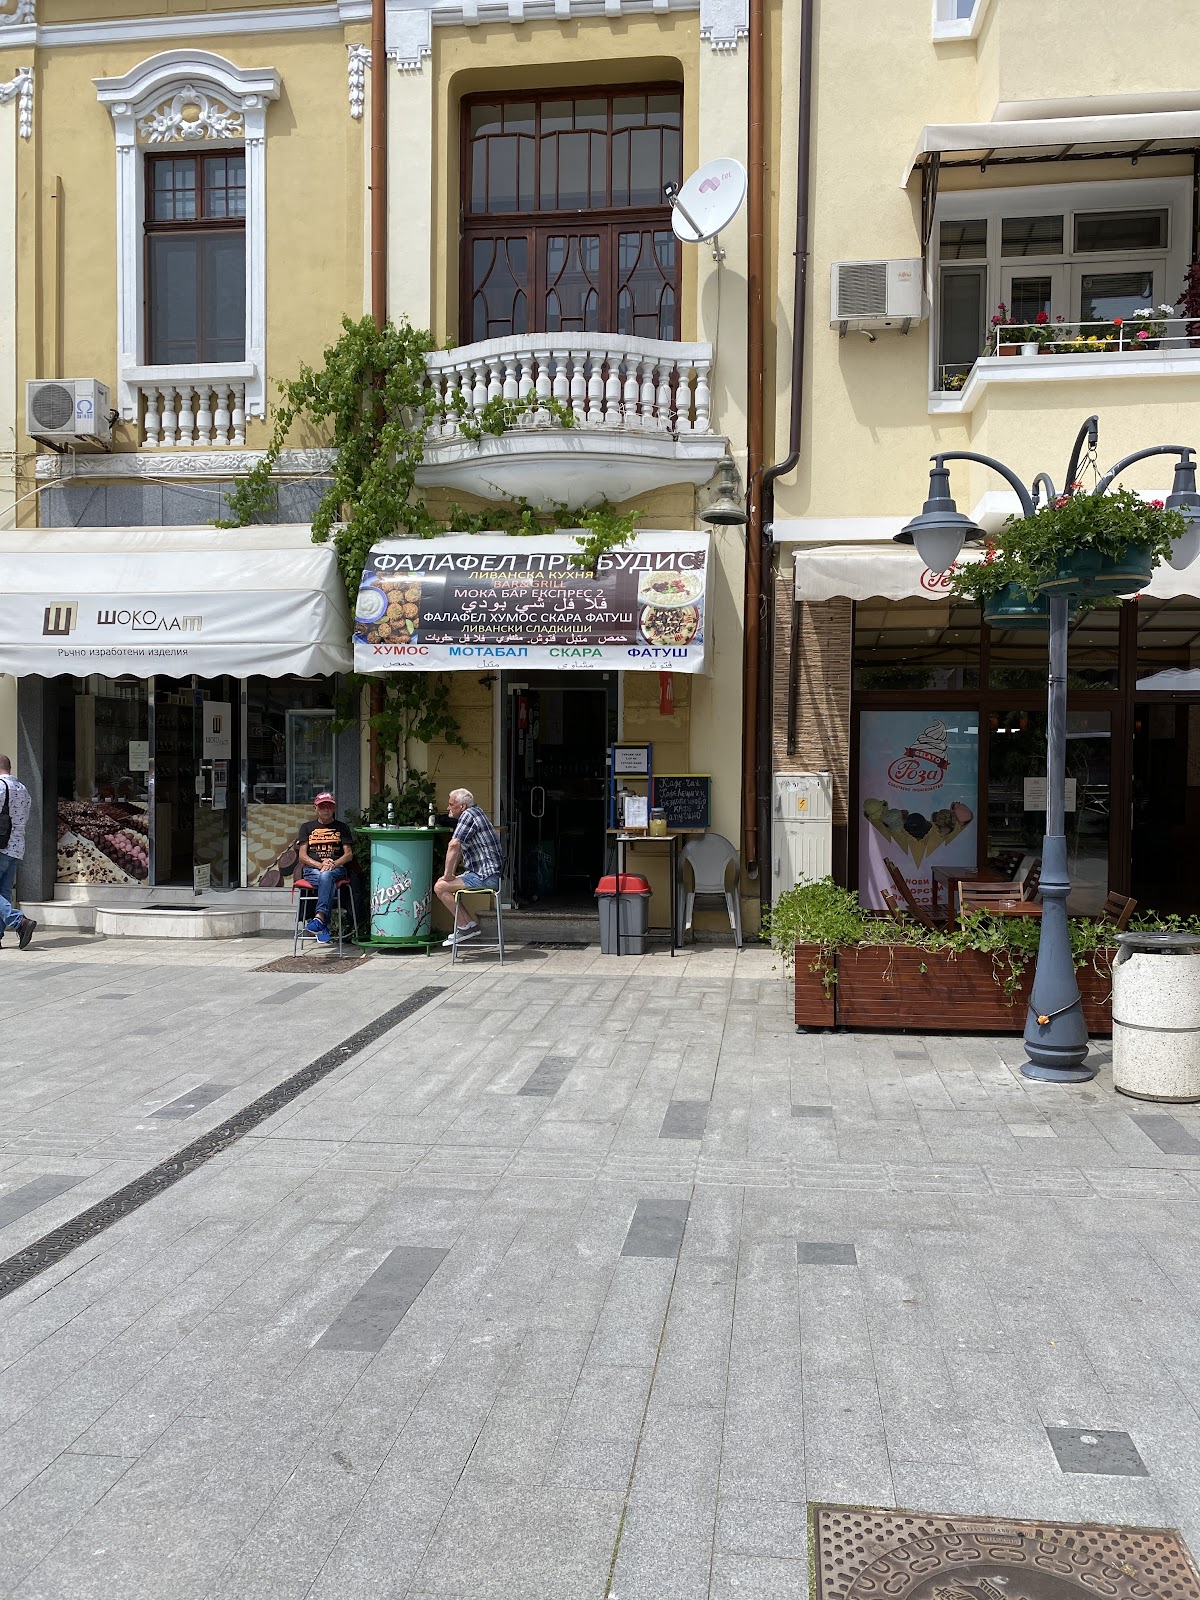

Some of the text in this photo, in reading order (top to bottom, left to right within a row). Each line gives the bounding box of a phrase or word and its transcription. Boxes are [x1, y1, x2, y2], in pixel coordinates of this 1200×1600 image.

[373, 554, 517, 571] ФАЛАФЕЛ
[597, 552, 696, 575] БУДИС
[468, 571, 594, 580] ЛИВАНСКА КУХНЯ
[493, 580, 567, 588] BAR&GRILL
[454, 589, 604, 598] МОКА БАР ЕКСПРЕС 2
[423, 612, 633, 623] ФАЛАФЕЛ ХУМОС СКАРА ФАТУШ
[461, 625, 592, 634] ЛИВАНСКИ СЛАДКИШИ
[57, 647, 188, 657] Ръчно изработени изделия
[373, 645, 688, 658] ХУМОС МОТАБАЛ СКАРА ФАТУШ
[914, 750, 941, 763] GELATO
[894, 759, 938, 785] Роза
